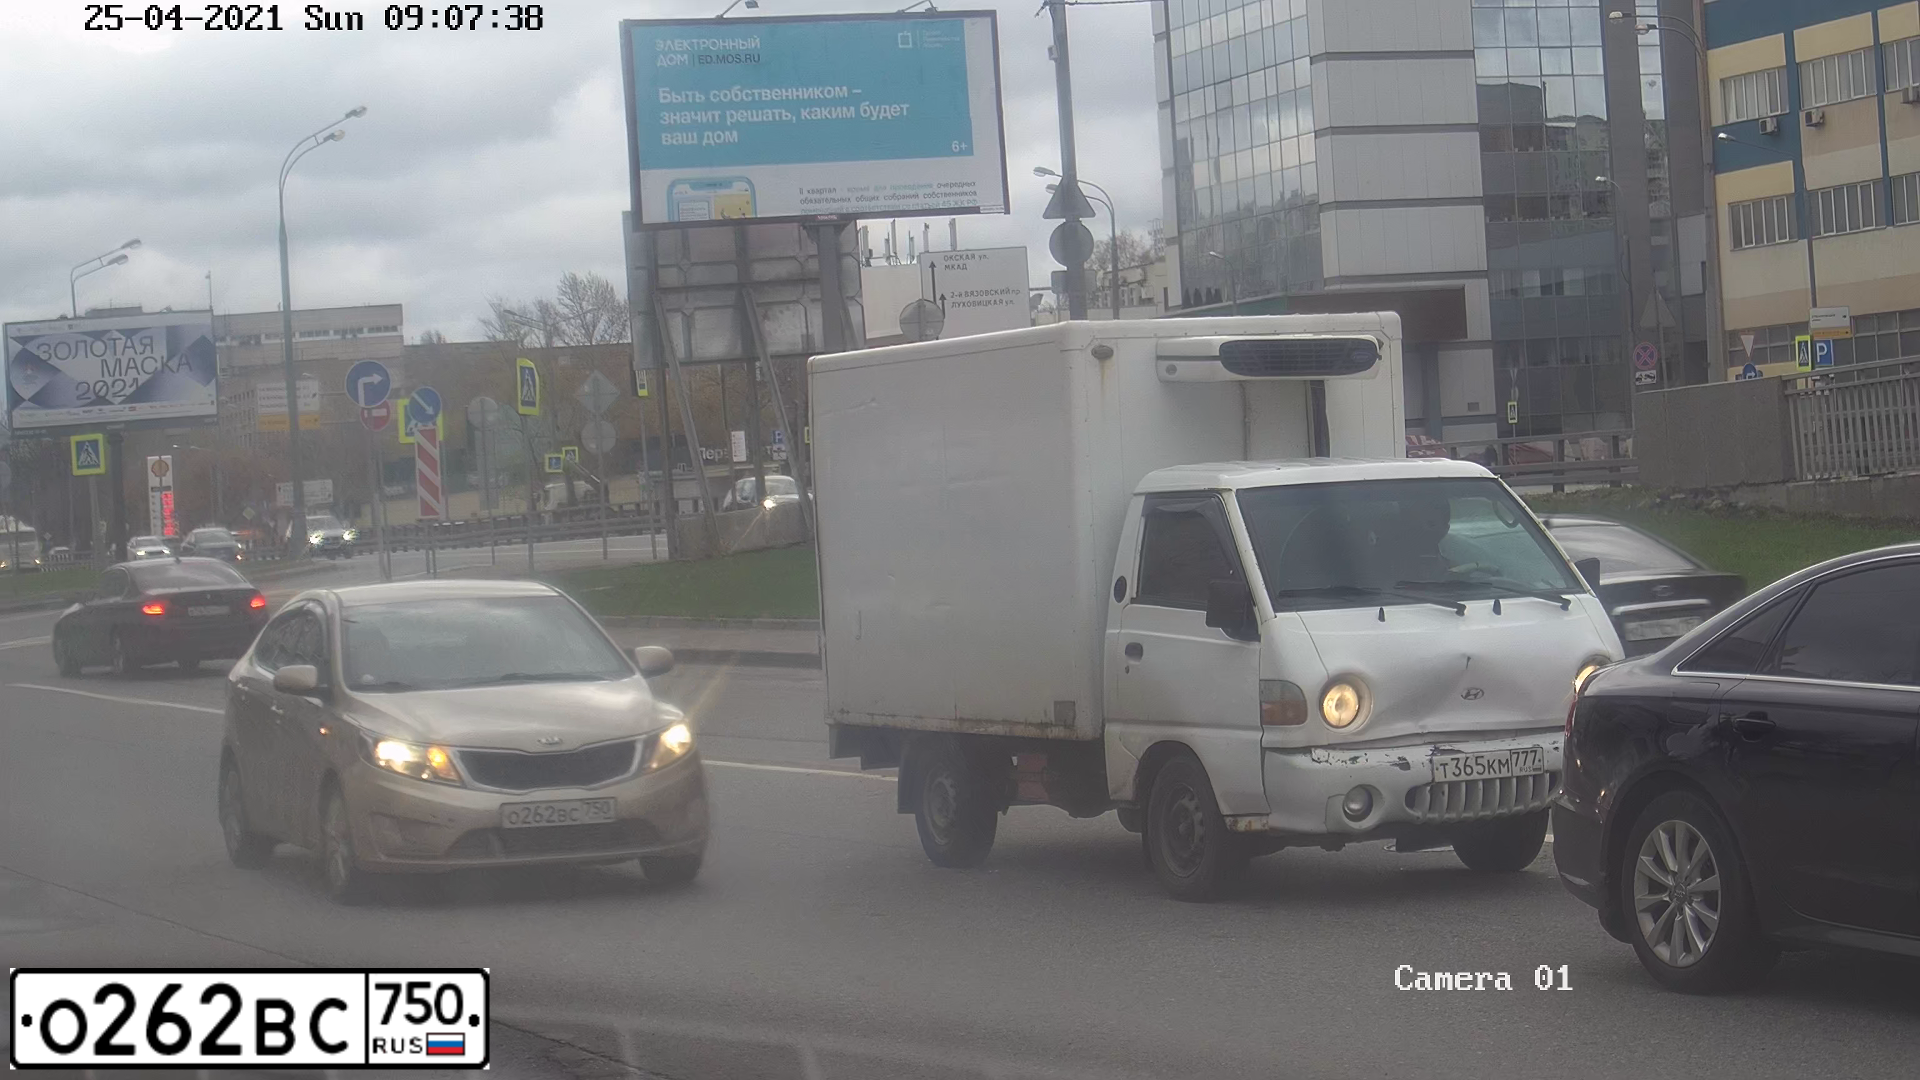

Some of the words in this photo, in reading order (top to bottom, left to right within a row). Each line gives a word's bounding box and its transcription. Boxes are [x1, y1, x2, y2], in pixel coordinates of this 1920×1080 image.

[655, 35, 761, 51] ЭЛЕКТРОННЫЙ
[657, 53, 689, 67] ДОМ
[698, 53, 761, 65] ED.MOS.RU
[658, 87, 705, 103] Быть
[709, 85, 848, 103] собственником
[659, 110, 721, 125] значит
[725, 107, 796, 126] решать,
[801, 104, 856, 121] каким
[859, 101, 910, 120] будет
[661, 131, 698, 146] ваш
[702, 130, 739, 147] дом
[951, 140, 968, 152] 6+
[807, 186, 837, 197] квартал
[937, 180, 976, 190] очередных
[800, 195, 851, 206] обязательных
[855, 194, 880, 204] общих
[883, 192, 919, 202] собраний
[923, 189, 978, 200] собственников
[943, 253, 976, 262] ОКСКАЯ
[944, 263, 968, 272] МКАД
[950, 291, 963, 299] 2-й
[964, 287, 1011, 299] ВЯЗОВСКИЙ
[37, 335, 155, 361] ЗОЛОТАЯ
[101, 355, 193, 378] МАСКА
[76, 377, 140, 401] 2021
[1439, 755, 1510, 779] Т365КМ
[1511, 750, 1538, 768] 777
[508, 806, 580, 825] О262ВС
